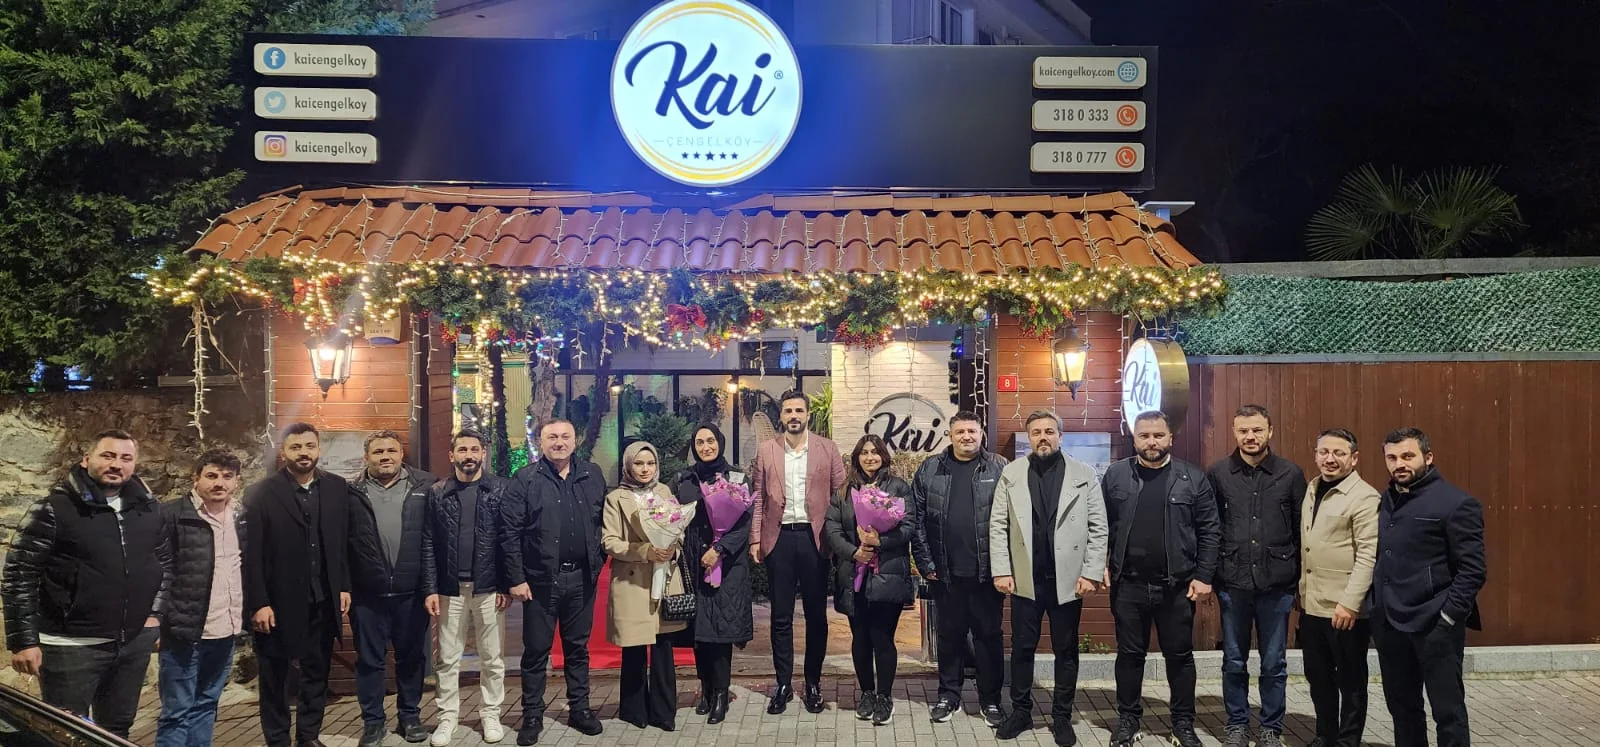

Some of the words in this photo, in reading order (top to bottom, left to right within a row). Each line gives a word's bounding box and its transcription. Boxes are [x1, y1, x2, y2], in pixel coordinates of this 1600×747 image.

[294, 52, 367, 70] kaicengelkoy
[1039, 65, 1115, 79] kaicengelkoy.com
[624, 41, 776, 129] Kai
[294, 95, 367, 113] kaicengelkoy
[1053, 108, 1074, 121] 318
[1077, 108, 1085, 121] 0
[1088, 108, 1109, 121] 333
[294, 139, 368, 157] kaicengelkoy
[1052, 151, 1073, 163] 318
[1076, 151, 1083, 163] 0
[1087, 151, 1107, 163] 777
[1004, 378, 1010, 388] 8
[1124, 360, 1158, 411] Kai
[864, 411, 943, 453] Kai
